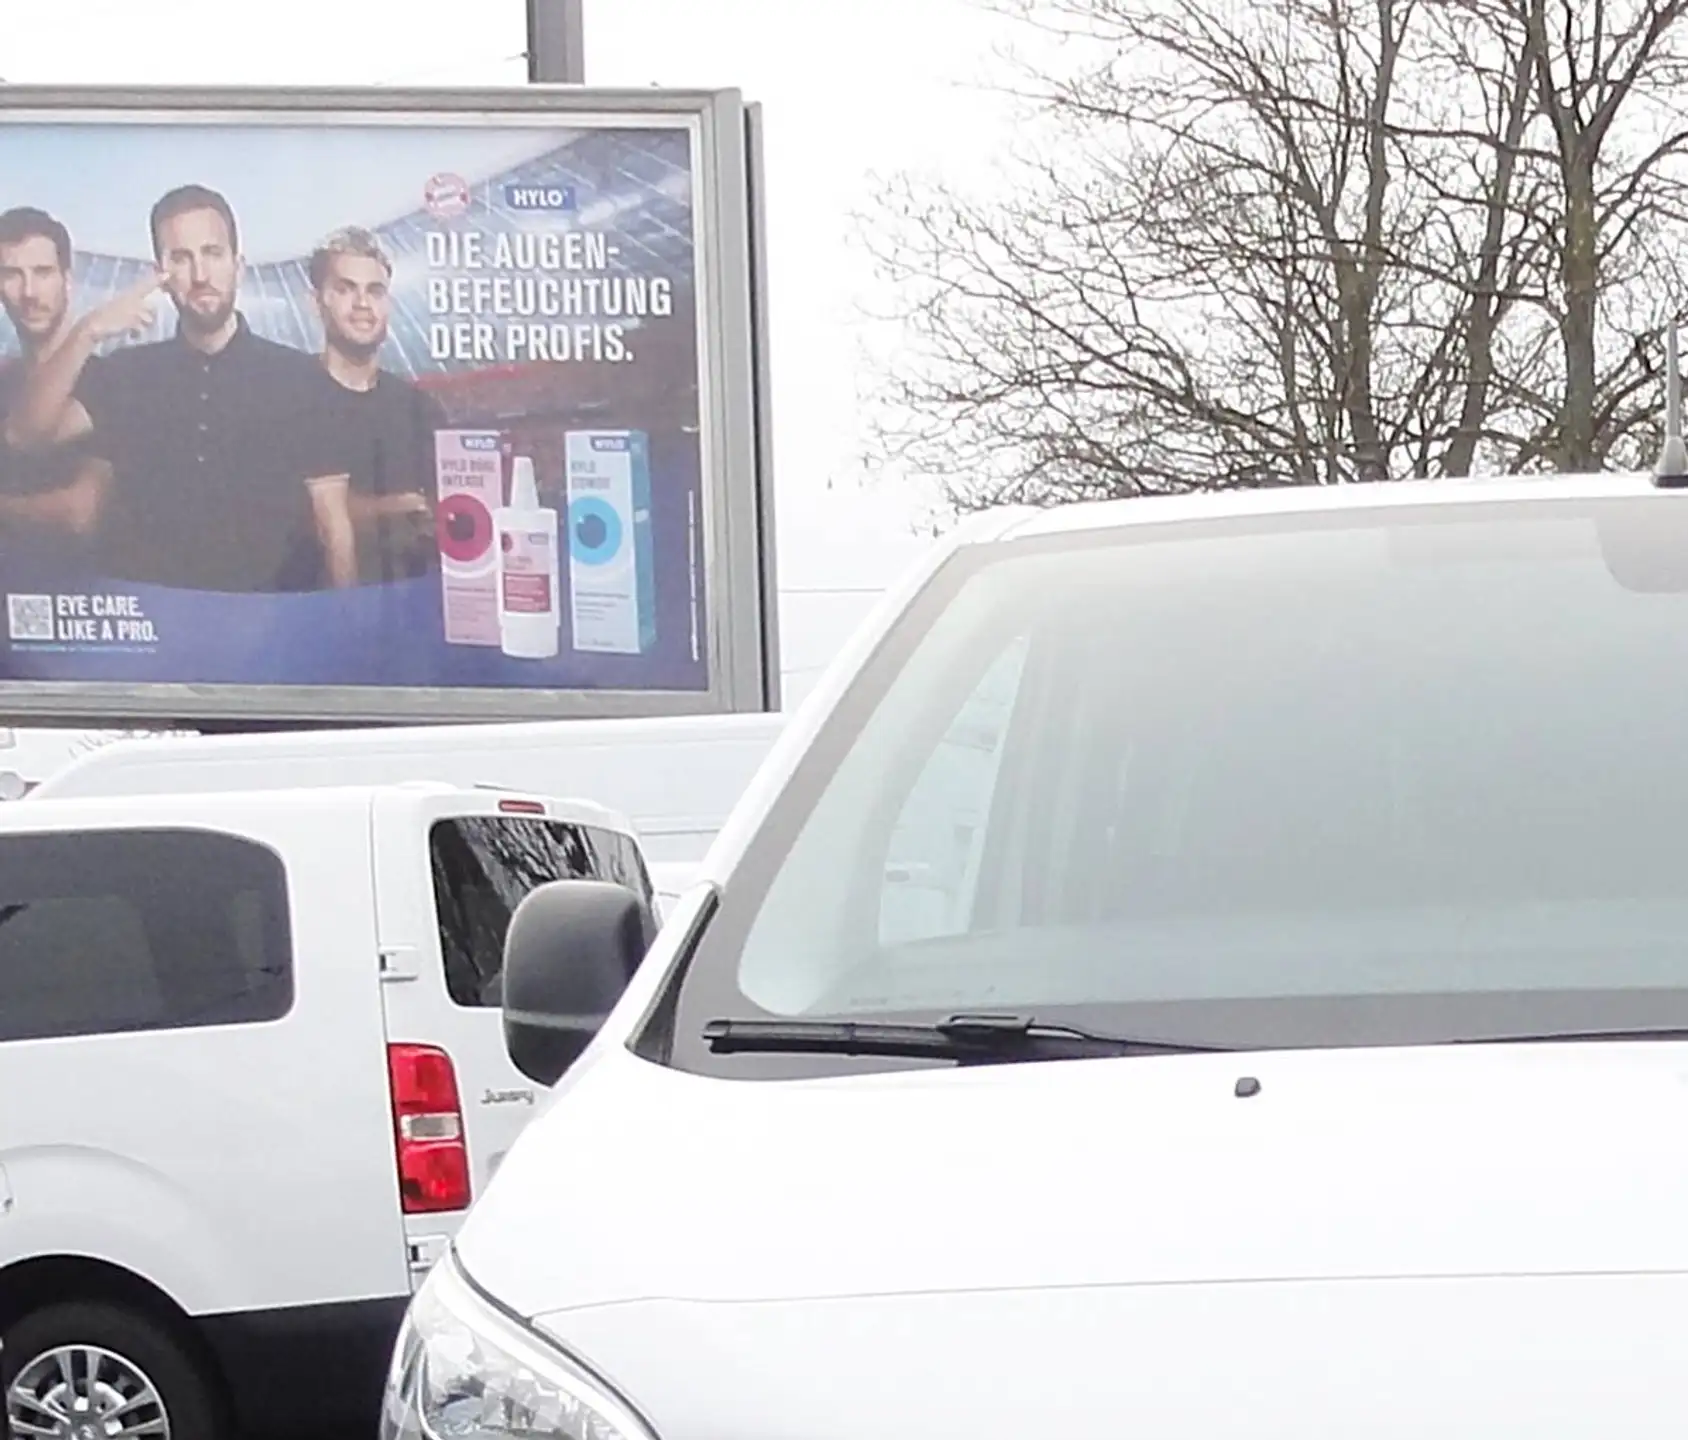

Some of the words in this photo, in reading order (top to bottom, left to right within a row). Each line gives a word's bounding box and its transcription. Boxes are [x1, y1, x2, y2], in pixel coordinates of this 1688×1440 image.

[513, 188, 563, 207] HYLO
[426, 231, 482, 269] DIE
[493, 231, 620, 270] AUGEN-
[427, 276, 672, 316] BEFEUCHTUNG
[430, 323, 496, 361] DER
[507, 323, 634, 362] PROFIS.
[57, 594, 89, 616] EYE
[92, 594, 144, 617] CARE.
[57, 618, 97, 641] LIKE
[101, 619, 114, 641] A
[117, 619, 159, 641] PRO.
